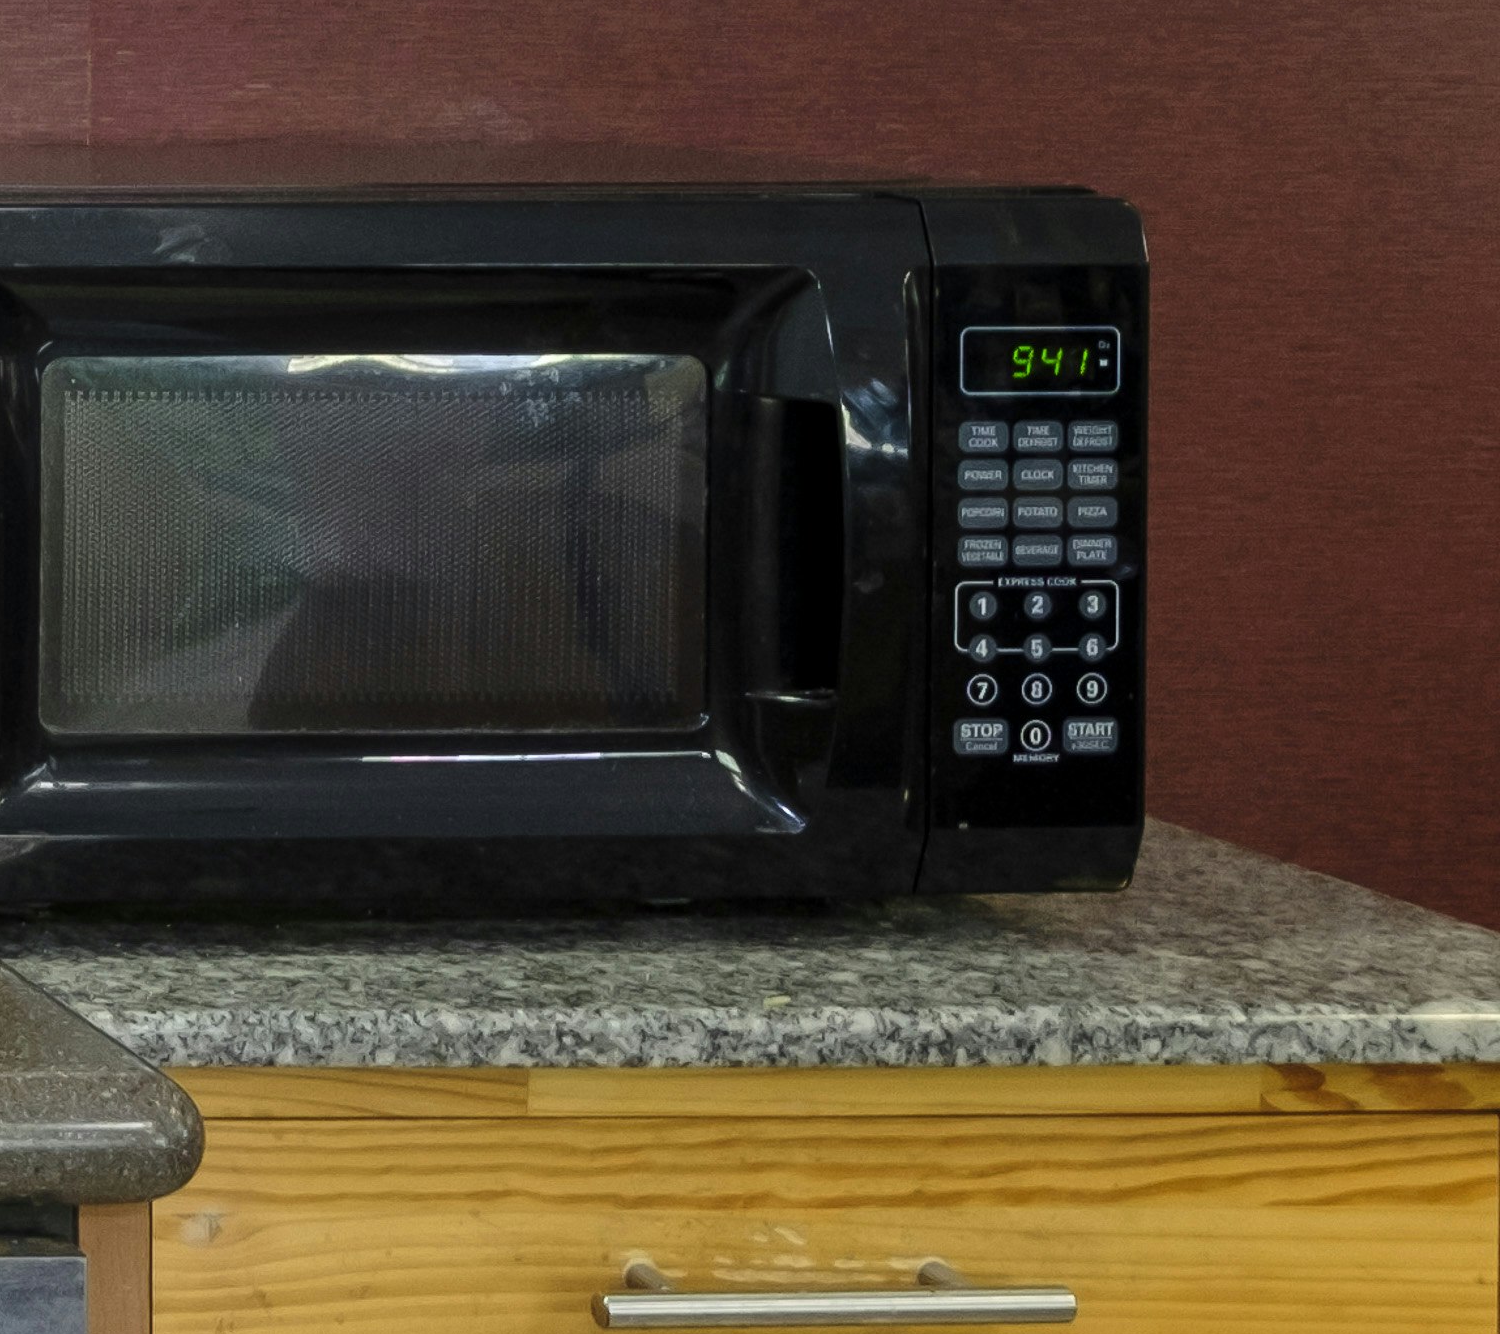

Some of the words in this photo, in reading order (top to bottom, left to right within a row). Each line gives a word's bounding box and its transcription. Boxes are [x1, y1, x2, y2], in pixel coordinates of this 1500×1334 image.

[971, 426, 996, 436] TIME
[1027, 426, 1050, 436] TIME
[968, 438, 999, 448] COOK
[1018, 438, 1058, 447] DEFROST
[1072, 464, 1113, 474] KITCHEN
[964, 470, 1002, 480] POWER
[1021, 470, 1054, 480] CLOCK
[1079, 475, 1107, 485] TIMER
[962, 508, 1004, 517] POPCORN
[1018, 507, 1058, 517] POTATO
[1078, 506, 1107, 516] PIZZA
[964, 540, 1002, 549] FROZEN
[1015, 545, 1059, 555] BEVERAGE
[1076, 550, 1107, 560] PLATE
[998, 577, 1044, 587] EXPRESS
[1047, 577, 1077, 586] COOK
[977, 597, 986, 616] 1
[1031, 596, 1044, 614] 2
[1087, 595, 1098, 613] 3
[975, 639, 988, 657] 4
[1031, 639, 1042, 658] 5
[1086, 638, 1098, 656] 6
[977, 682, 988, 699] 7
[1031, 681, 1043, 699] 8
[1086, 680, 1098, 698] 9
[961, 724, 1003, 738] STOP
[1068, 722, 1114, 737] START
[1030, 727, 1041, 745] 0
[965, 741, 998, 751] Cancel
[1013, 755, 1060, 763] MEMORY
